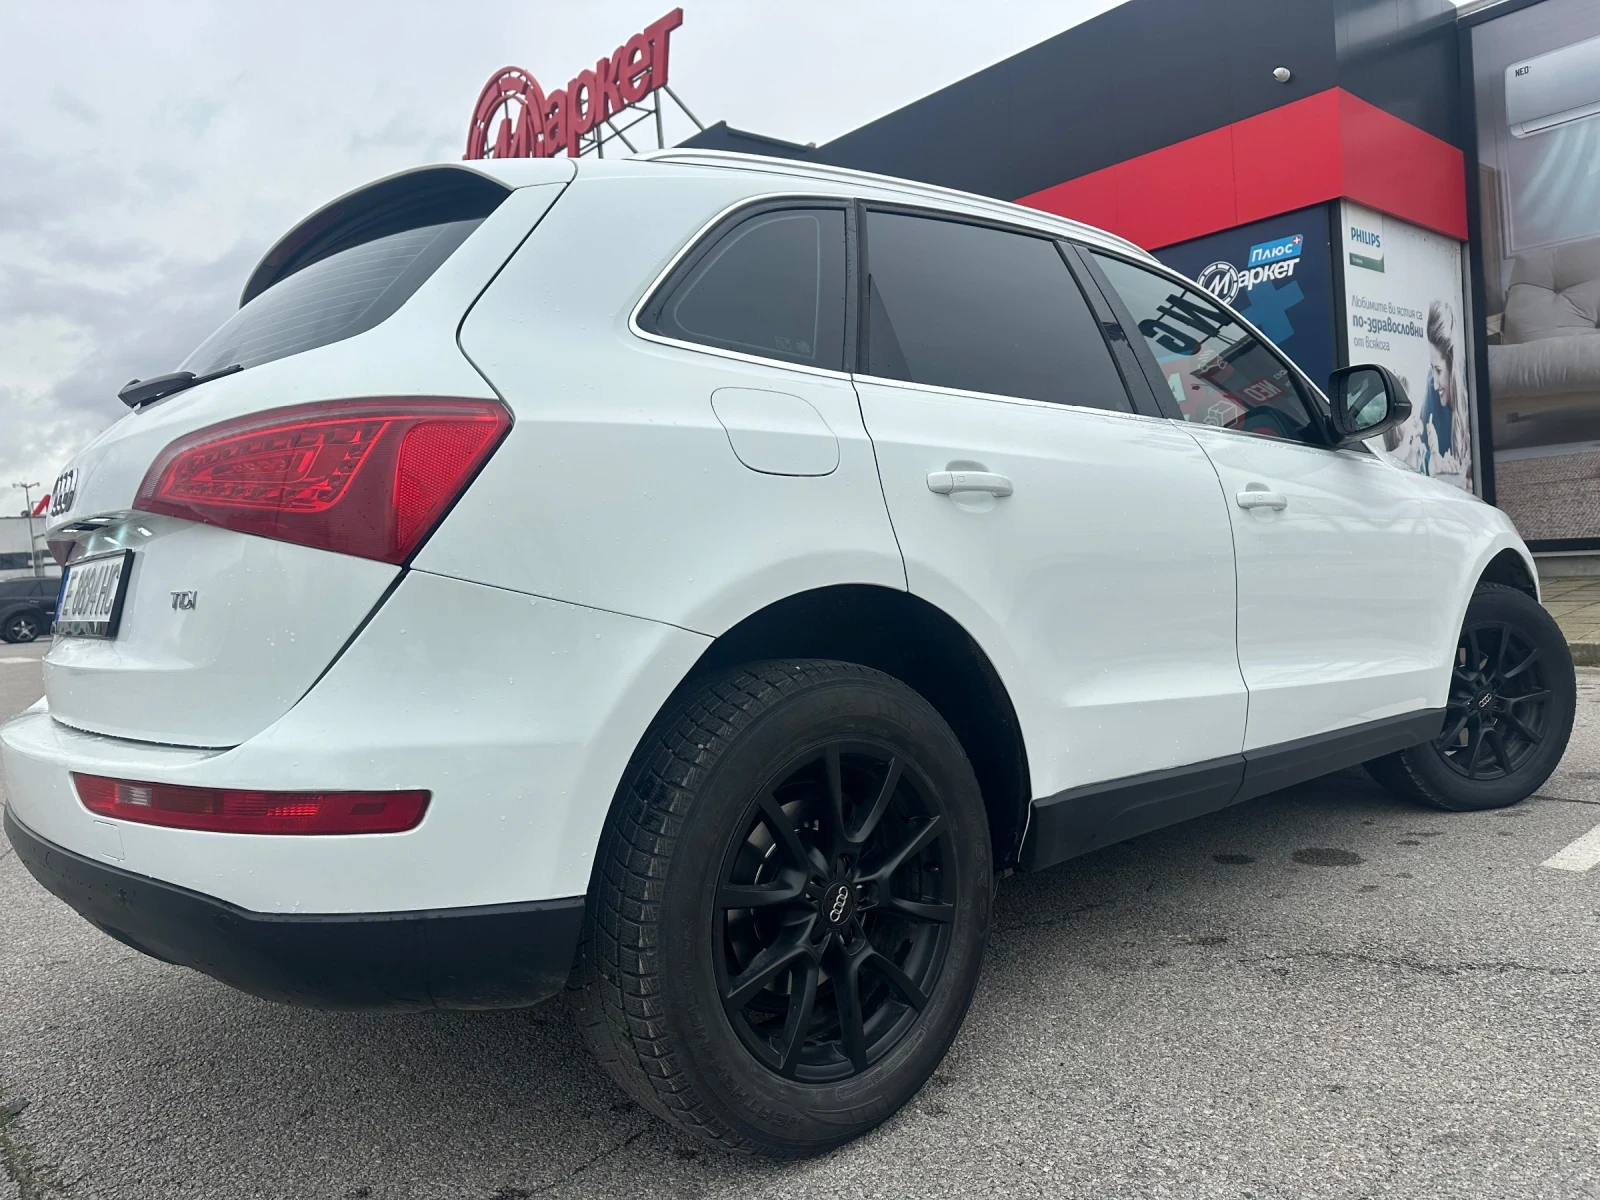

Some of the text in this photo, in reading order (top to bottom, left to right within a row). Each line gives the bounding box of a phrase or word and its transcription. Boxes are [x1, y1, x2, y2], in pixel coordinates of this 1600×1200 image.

[1515, 66, 1529, 77] NEO
[1350, 227, 1381, 248] PHILIPS
[1251, 243, 1293, 263] Плюс
[1207, 258, 1300, 296] Маркет
[1352, 314, 1424, 338] по-здравословни
